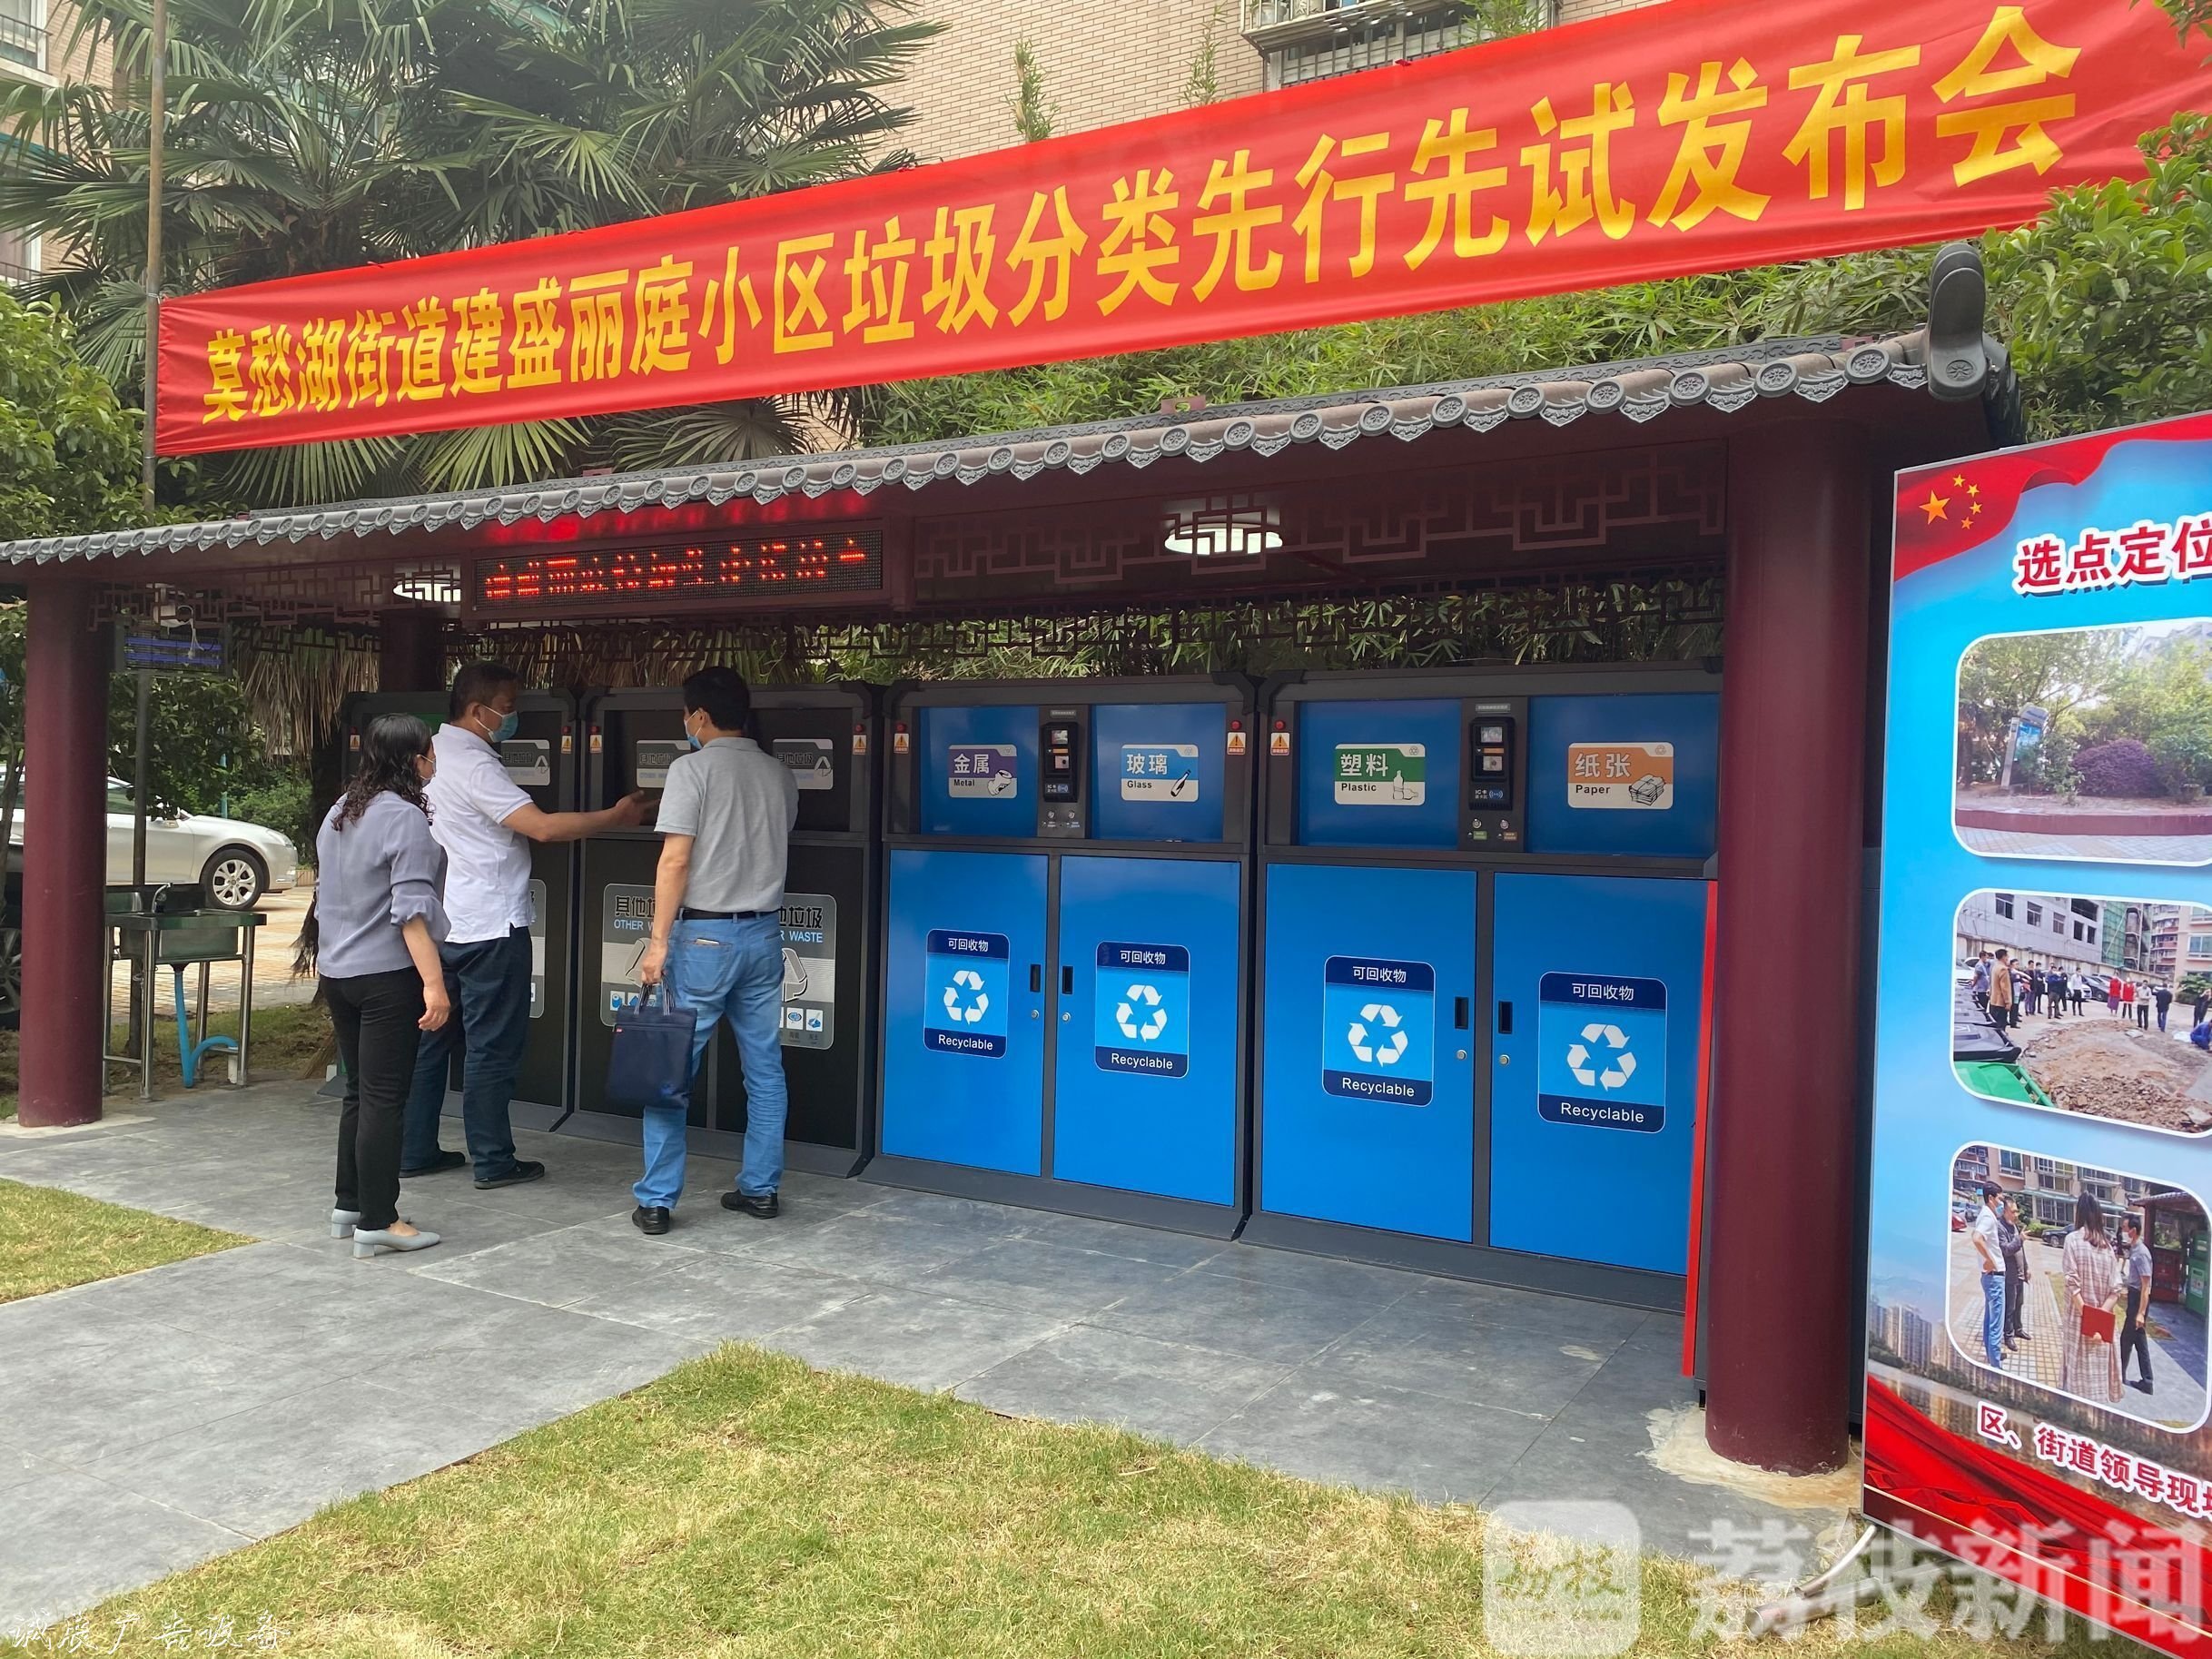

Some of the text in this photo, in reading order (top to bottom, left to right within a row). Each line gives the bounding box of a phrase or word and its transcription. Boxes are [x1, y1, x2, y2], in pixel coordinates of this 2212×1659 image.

[202, 5, 2082, 425] 莫愁湖街道建盛丽庭小区垃圾分类先行先试发布会
[953, 754, 990, 775] 金属
[1126, 753, 1169, 775] 玻璃
[1340, 752, 1389, 778] 塑料
[1575, 752, 1632, 779] 纸张
[953, 778, 975, 787] Metal
[1127, 780, 1152, 790] Glass
[1341, 781, 1378, 793] Plastic
[1575, 784, 1611, 796] Paper
[615, 895, 656, 918] 其他
[614, 919, 644, 931] OTHER
[779, 905, 823, 929] 垃圾
[789, 930, 823, 943] WASTE
[948, 937, 989, 953] 可回收物
[1120, 950, 1166, 965] 可回收物
[1352, 965, 1407, 983] 可回收物
[1572, 983, 1634, 1001] 可回收物
[938, 1034, 993, 1051] Recyclable
[1111, 1053, 1173, 1071] Recyclable
[1342, 1077, 1415, 1098] Recyclable
[1561, 1102, 1644, 1124] Recyclable
